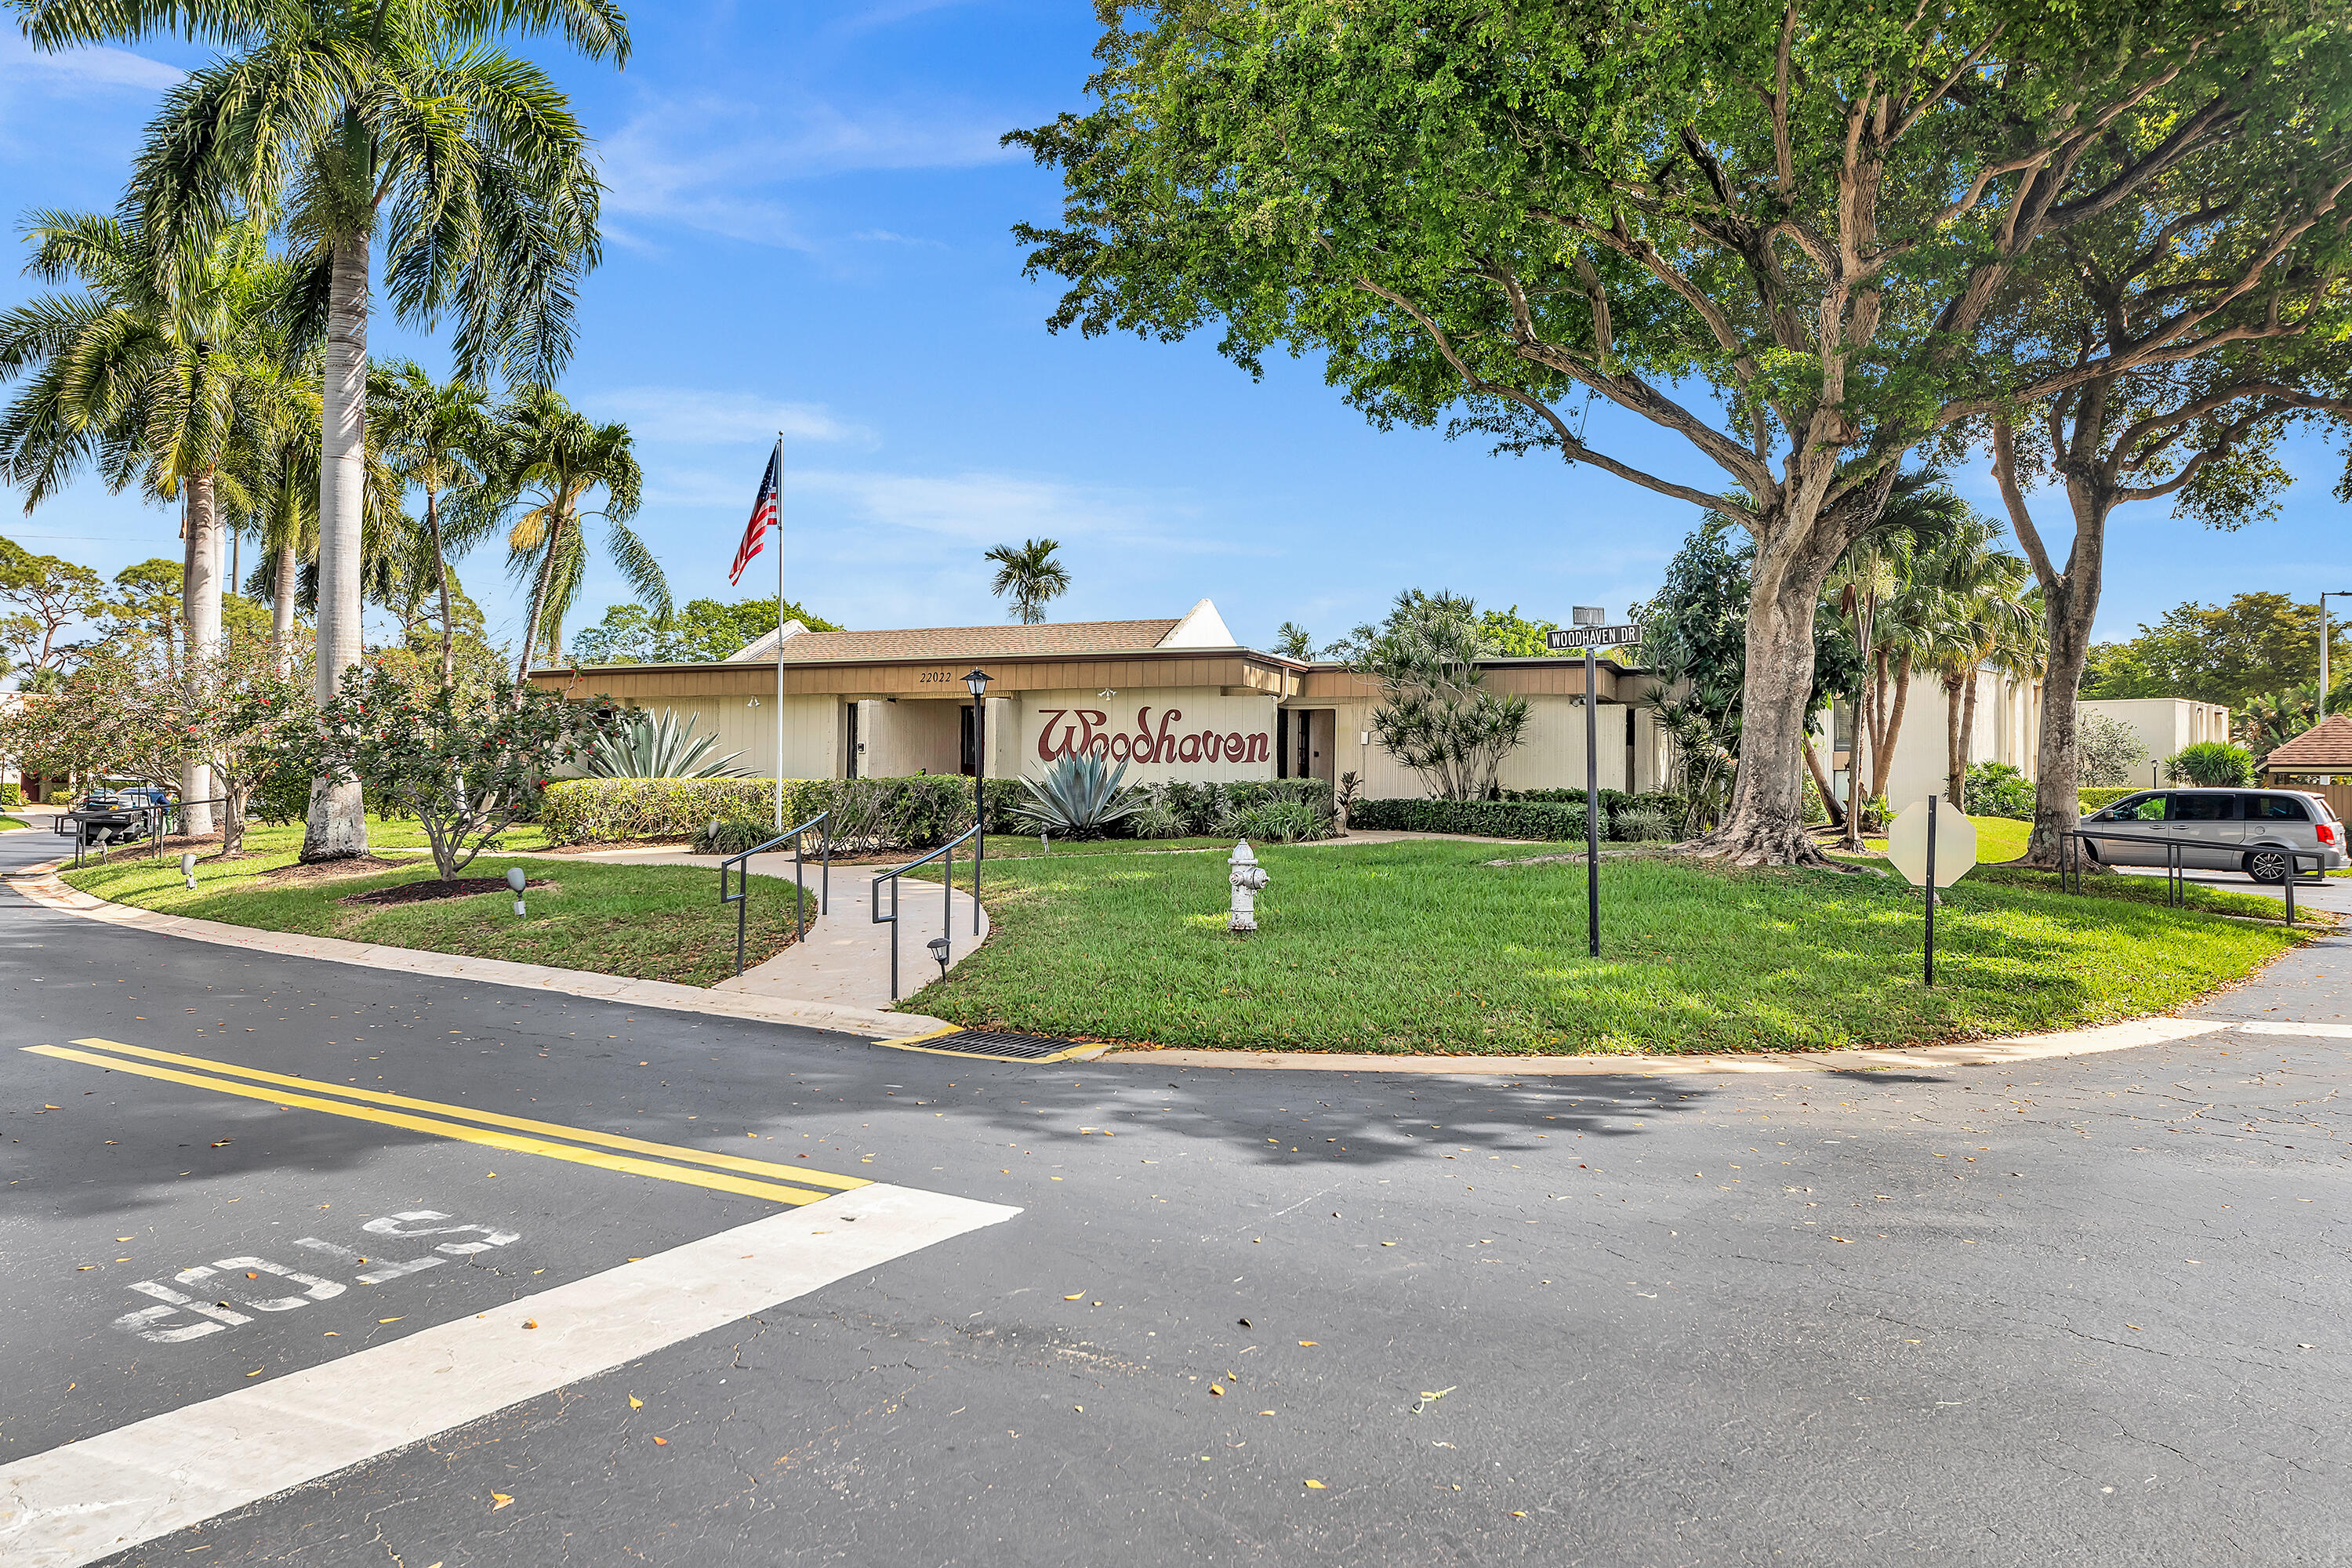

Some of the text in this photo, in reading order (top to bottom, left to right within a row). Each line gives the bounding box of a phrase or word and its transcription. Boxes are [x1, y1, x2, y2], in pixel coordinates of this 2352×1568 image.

[1552, 627, 1636, 647] WOODHAVEN DR
[920, 672, 951, 682] 22022
[1038, 706, 1270, 764] Woodhaven
[112, 1210, 521, 1343] STOP
